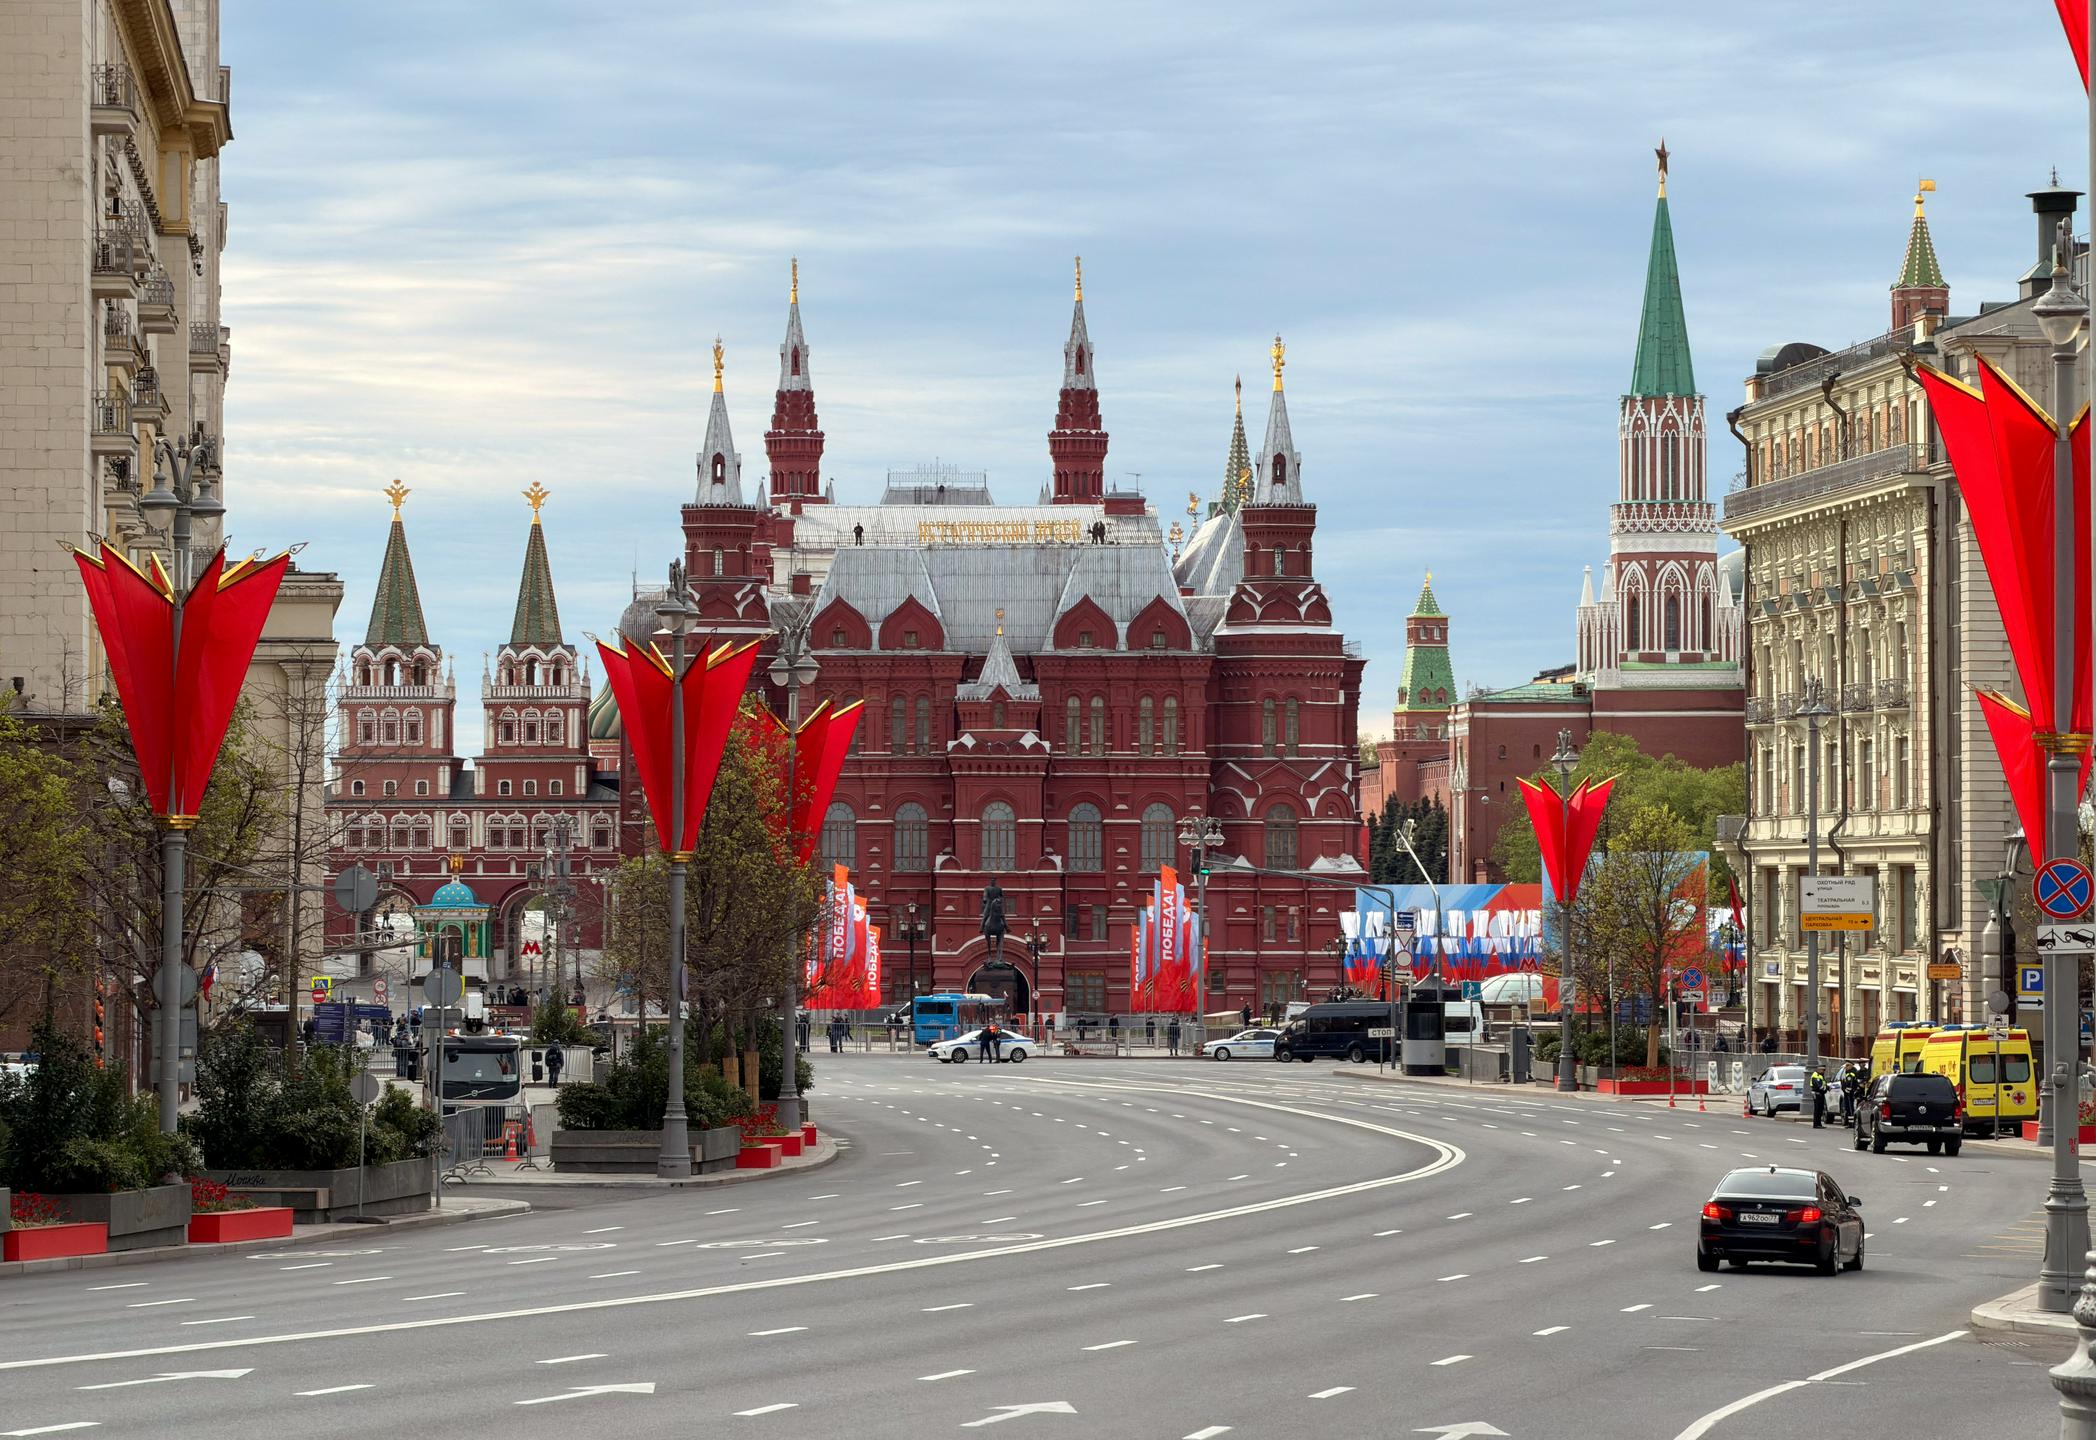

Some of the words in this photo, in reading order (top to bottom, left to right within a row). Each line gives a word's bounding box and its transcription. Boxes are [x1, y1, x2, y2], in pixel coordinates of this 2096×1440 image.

[833, 887, 846, 958] ПОБЕДА!
[1162, 889, 1175, 961] ПОБЕДА!
[868, 930, 878, 991] ПОБЕДА!
[1371, 1029, 1392, 1037] СТОП
